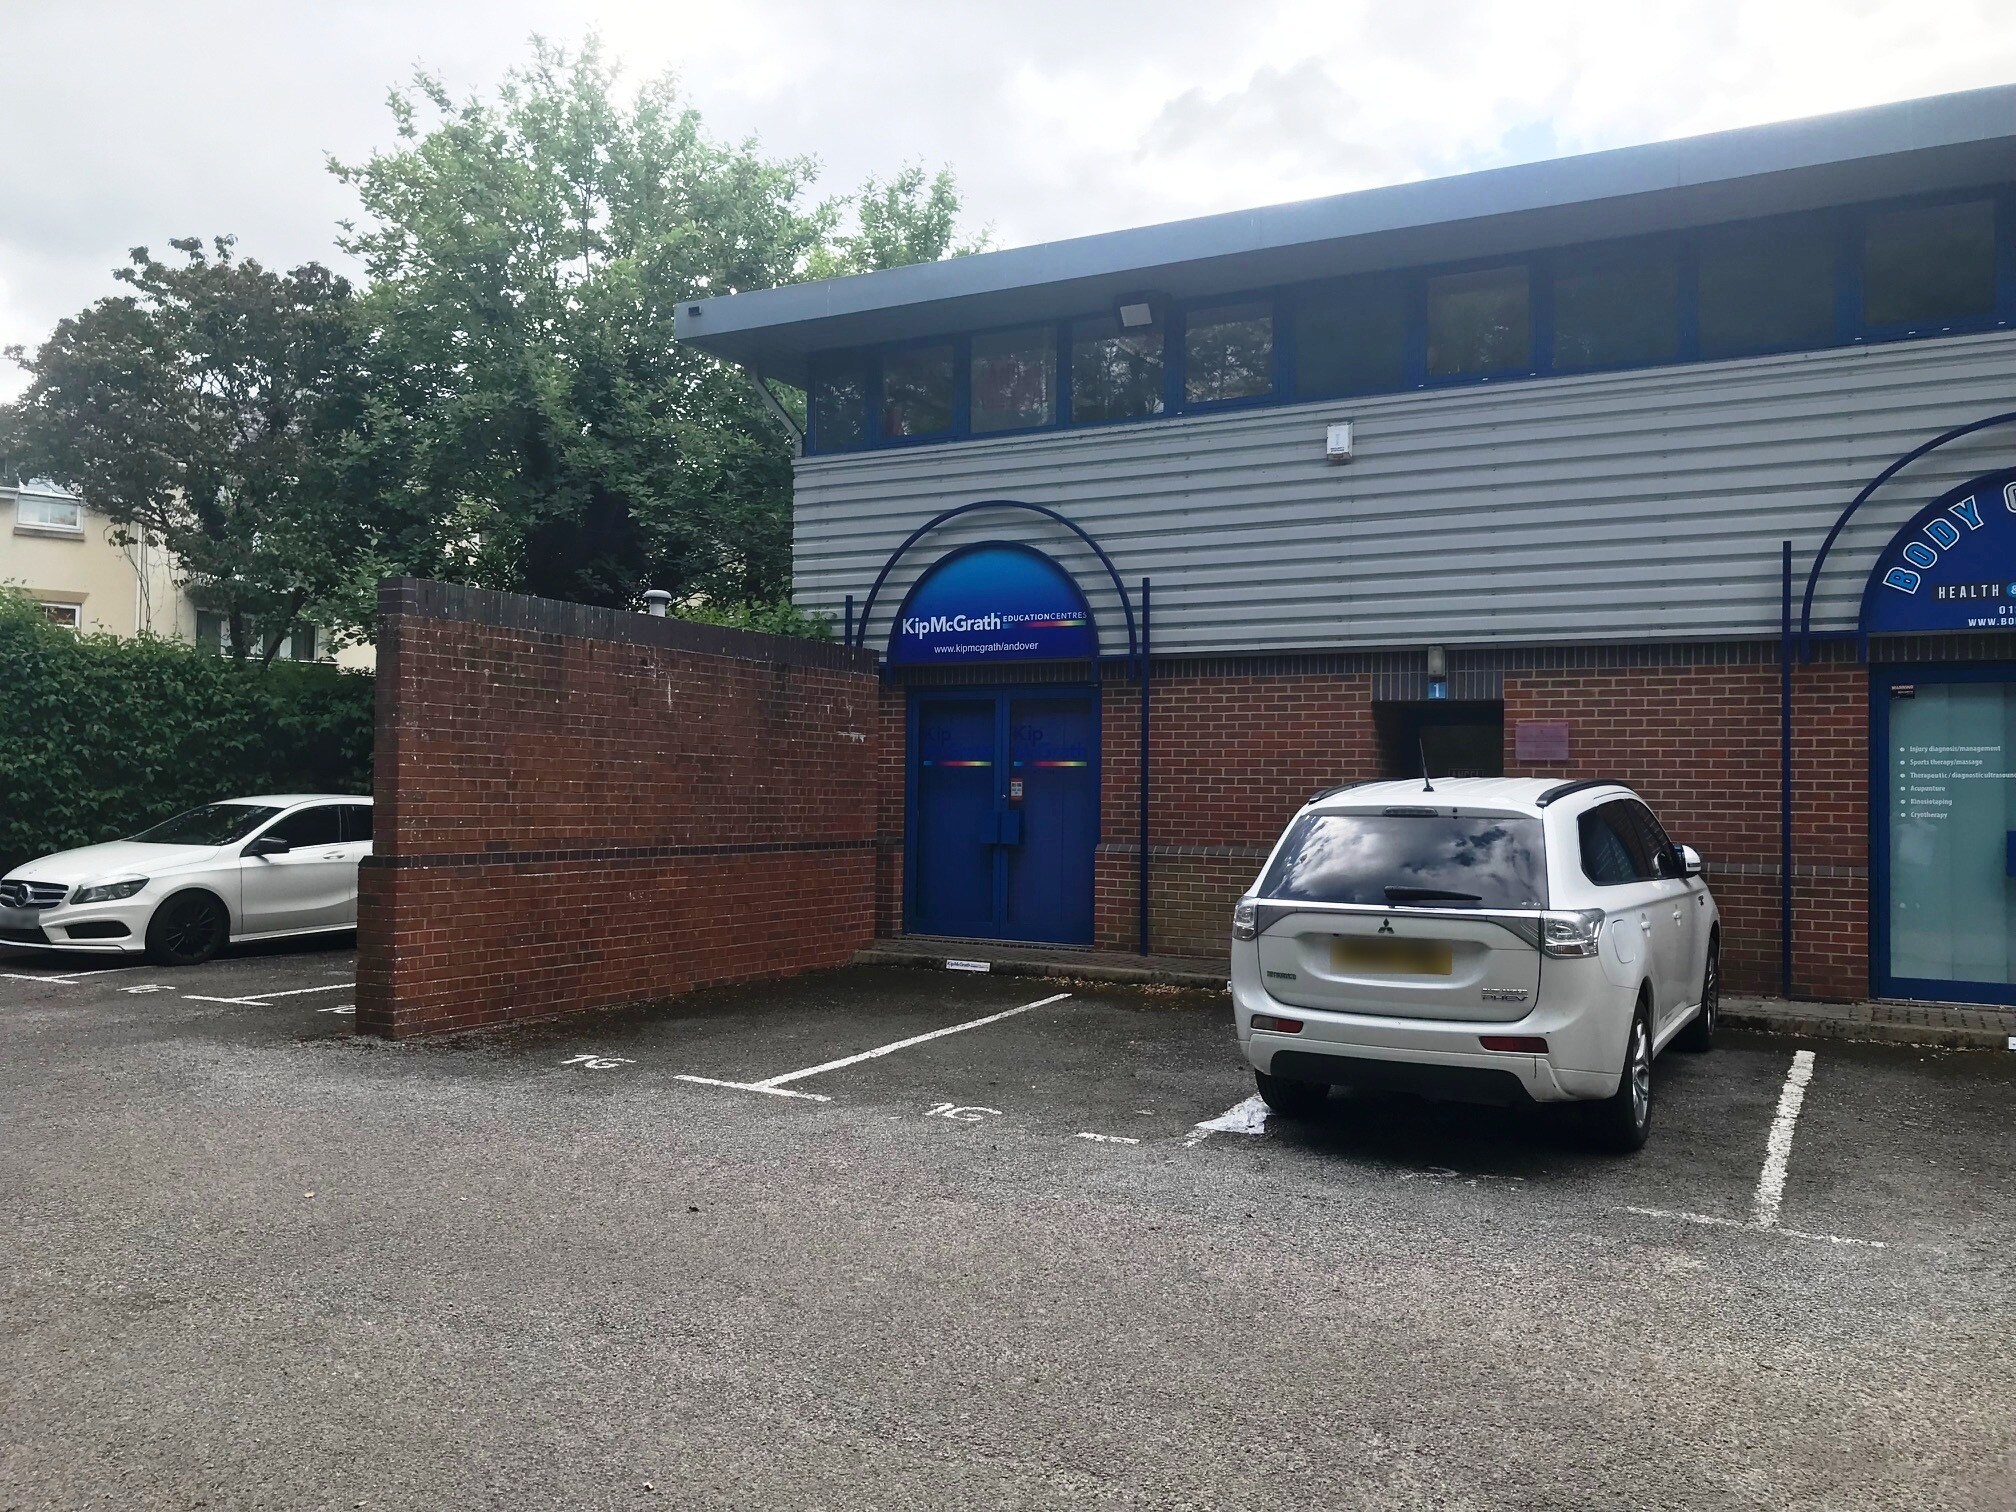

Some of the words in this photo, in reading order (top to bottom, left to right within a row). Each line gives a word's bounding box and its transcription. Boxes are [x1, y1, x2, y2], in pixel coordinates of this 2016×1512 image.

[1883, 495, 1984, 594] BODY
[1938, 585, 1999, 599] HEALTH
[1998, 605, 2016, 615] 01
[1967, 617, 2016, 627] WWW.BO
[934, 640, 1039, 654] www.kipmcgrath/andover
[1433, 683, 1440, 697] 1
[1013, 725, 1044, 747] Kip
[1929, 745, 2001, 753] diagnosis/management
[1930, 758, 1983, 766] therapy/massage
[1910, 798, 1953, 806] Kinesiotaping
[1910, 811, 1948, 819] Cryotherapy
